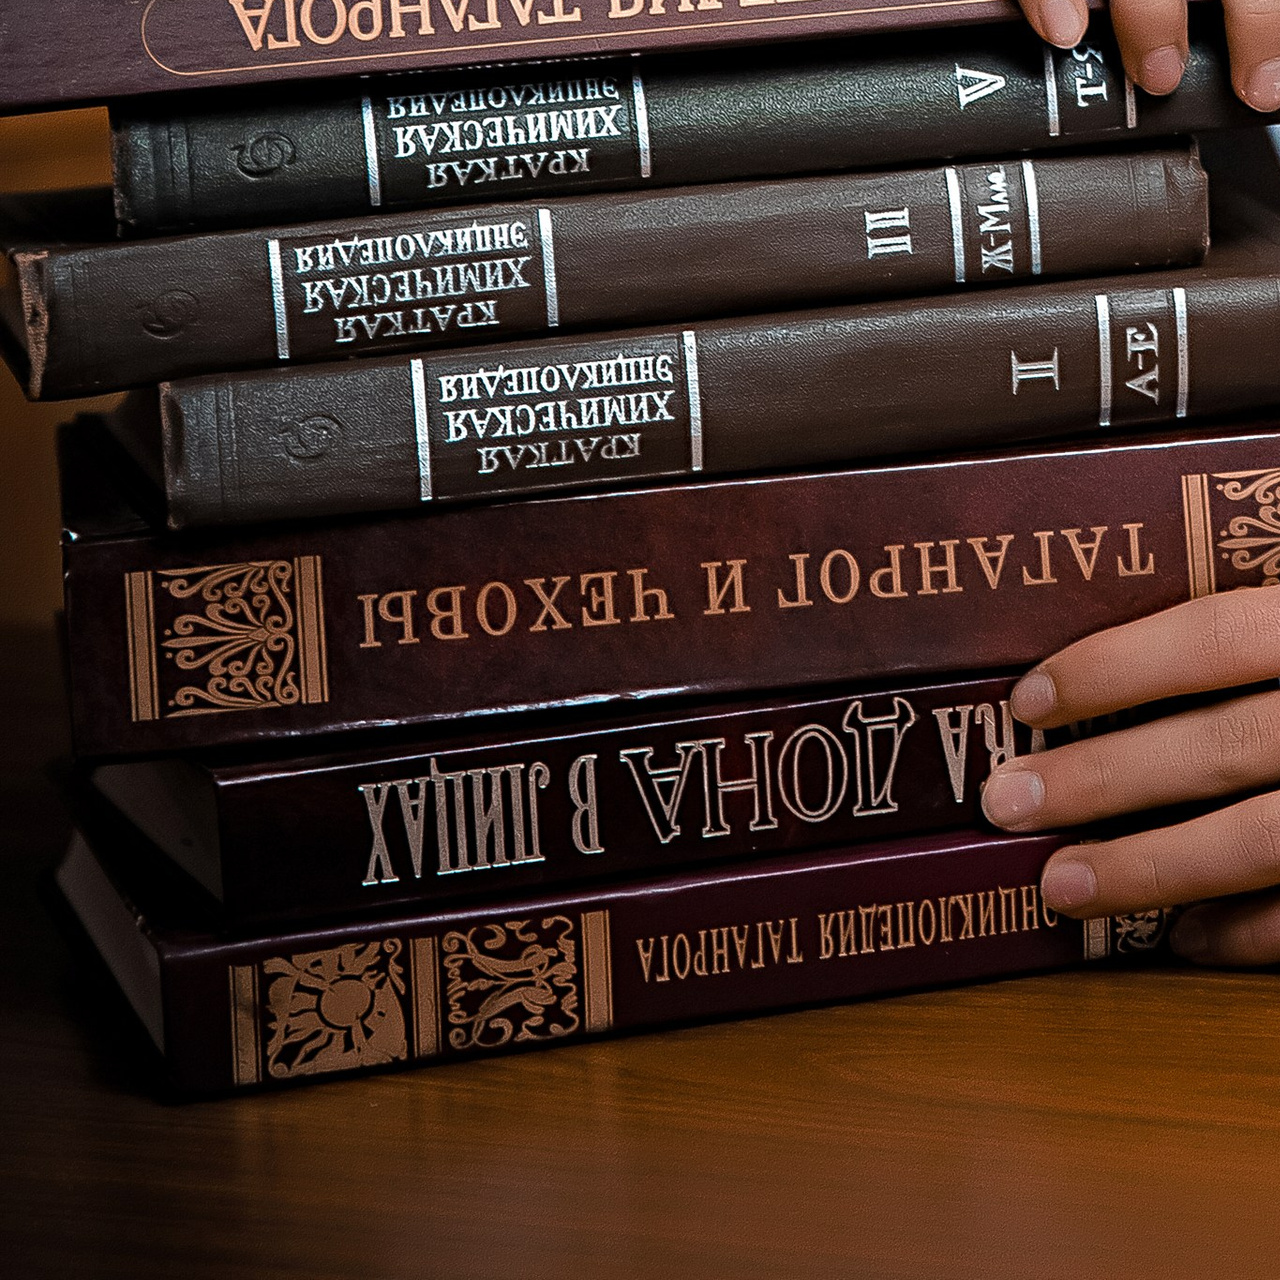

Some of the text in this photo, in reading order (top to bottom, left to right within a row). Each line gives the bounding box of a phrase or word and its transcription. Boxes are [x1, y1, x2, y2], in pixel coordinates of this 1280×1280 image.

[386, 77, 621, 120] ЭНЦИКЛОПЕДИЯ
[954, 62, 1006, 110] V
[392, 104, 623, 159] ХИМИЧЕСКАЯ
[425, 148, 591, 189] КРАТКАЯ
[293, 219, 530, 274] ЭНЦИКЛОПЕДИЯ
[301, 255, 532, 314] ХИМИЧЕСКАЯ
[333, 300, 501, 343] КРАТКАЯ
[437, 353, 675, 403] ЭНЦИКЛОПЕДИЯ
[442, 389, 677, 444] ХИМИЧЕСКАЯ
[476, 433, 642, 474] КРАТКАЯ
[356, 521, 1156, 649] ТАГАНРОГ И ЧЕХОВЫ
[619, 696, 917, 844] ДОНА
[358, 757, 551, 886] ЛИЦАХ
[568, 753, 605, 854] В
[636, 917, 804, 983] ТАГАНРОГА
